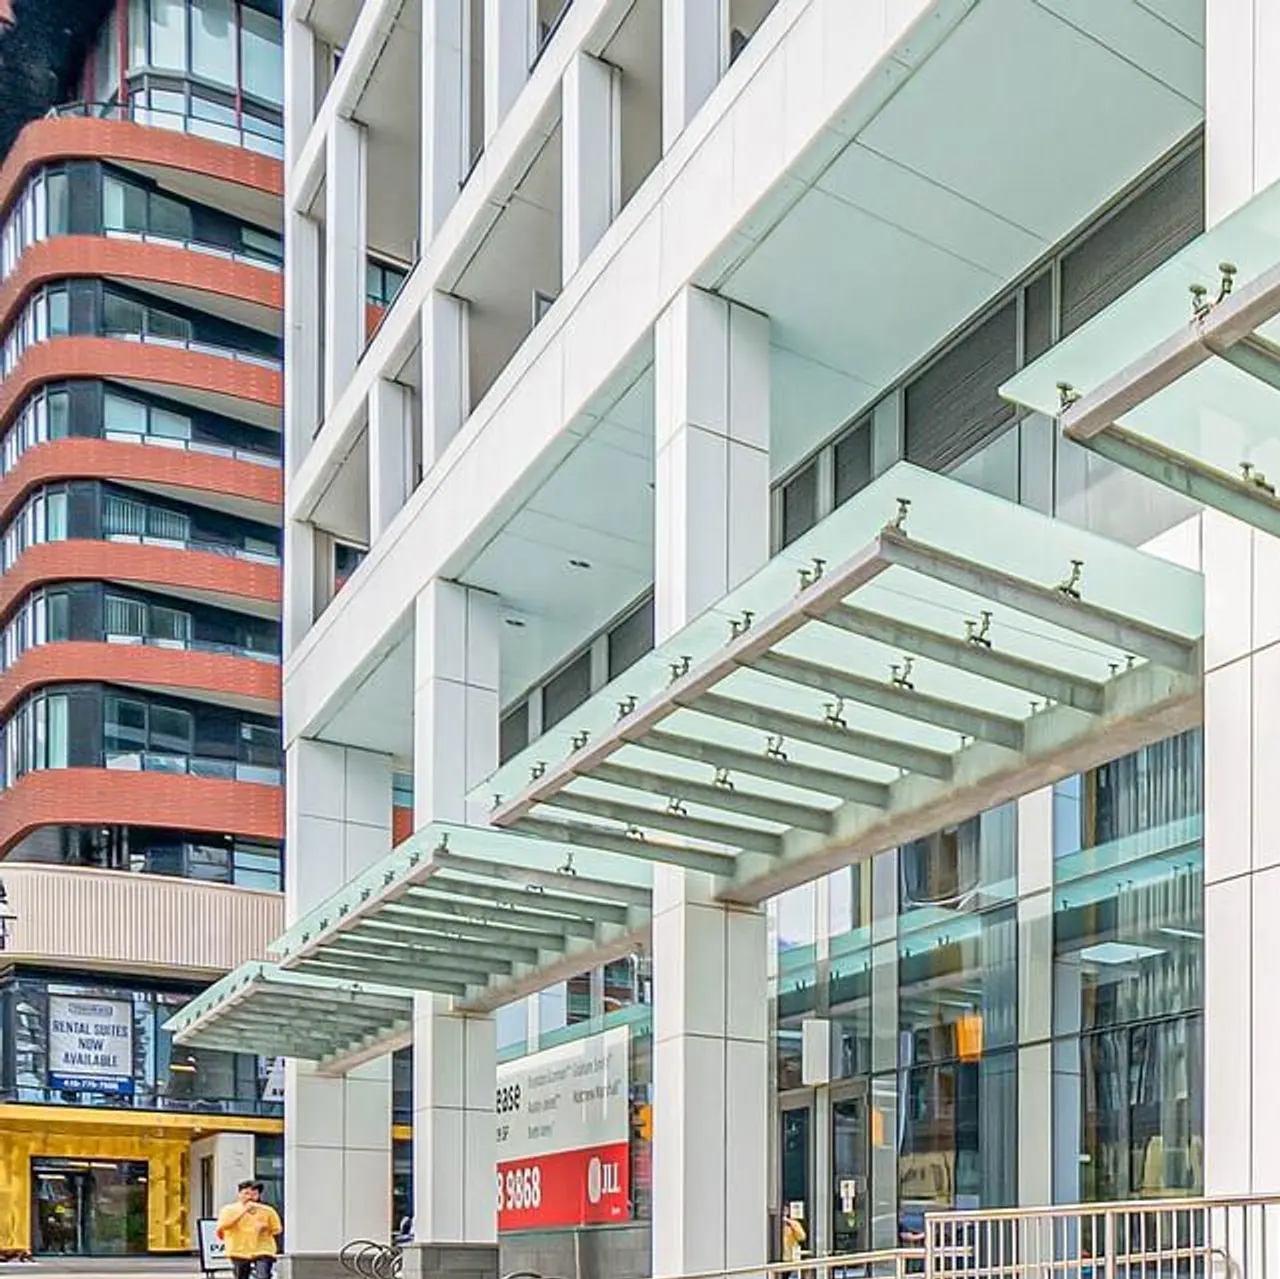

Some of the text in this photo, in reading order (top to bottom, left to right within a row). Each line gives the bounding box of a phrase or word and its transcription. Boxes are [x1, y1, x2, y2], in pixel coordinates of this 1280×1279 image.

[52, 1020, 129, 1037] RENTAL SUITES
[78, 1038, 103, 1051] NOW
[63, 1052, 118, 1067] AVAILABLE
[602, 1162, 621, 1195] JLL
[506, 1166, 541, 1210] 9868
